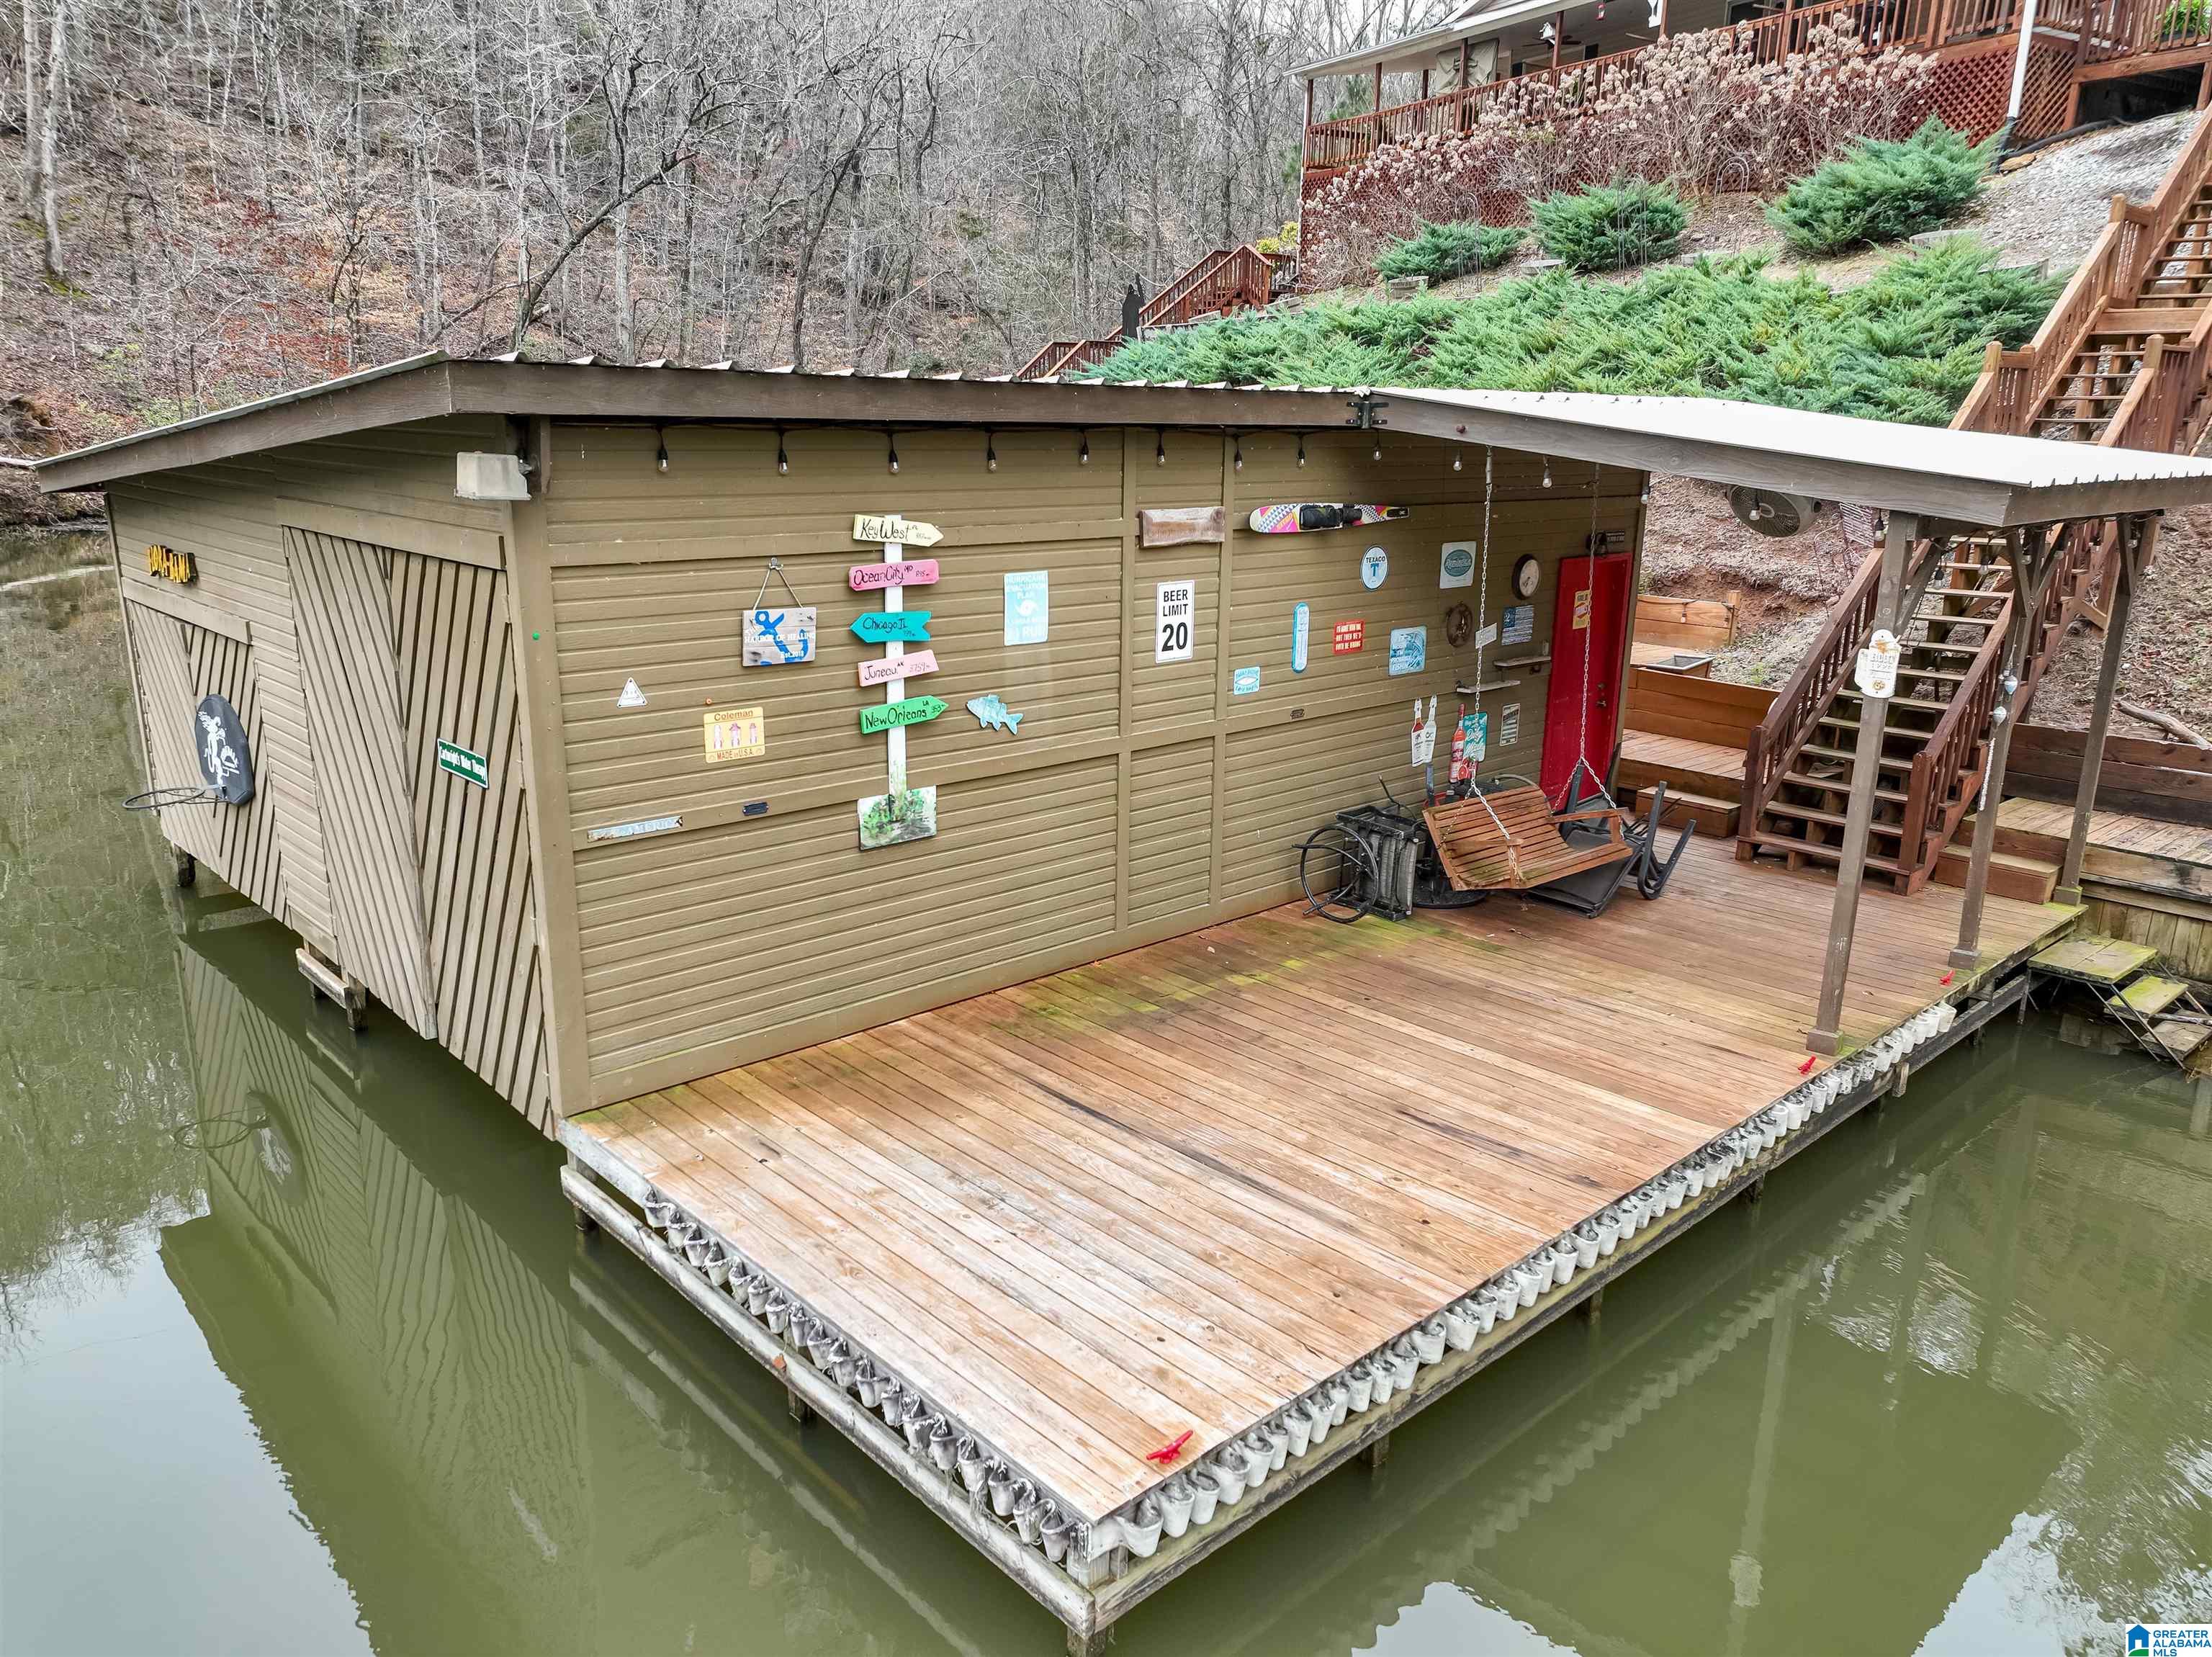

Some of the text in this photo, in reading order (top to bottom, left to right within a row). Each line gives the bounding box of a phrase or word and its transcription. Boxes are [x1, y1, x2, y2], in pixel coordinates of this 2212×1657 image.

[860, 518, 878, 539] Key
[879, 520, 909, 542] West
[854, 570, 886, 585] Ocean
[886, 565, 904, 585] City
[1164, 589, 1188, 602] BEER
[1163, 603, 1188, 616] LIMIT
[863, 616, 897, 634] Chicago
[1161, 621, 1188, 652] 20
[864, 665, 897, 681] Juneau
[714, 709, 754, 722] Coleman
[866, 711, 888, 729] New
[887, 706, 927, 724] Orleans
[716, 750, 733, 761] MADE
